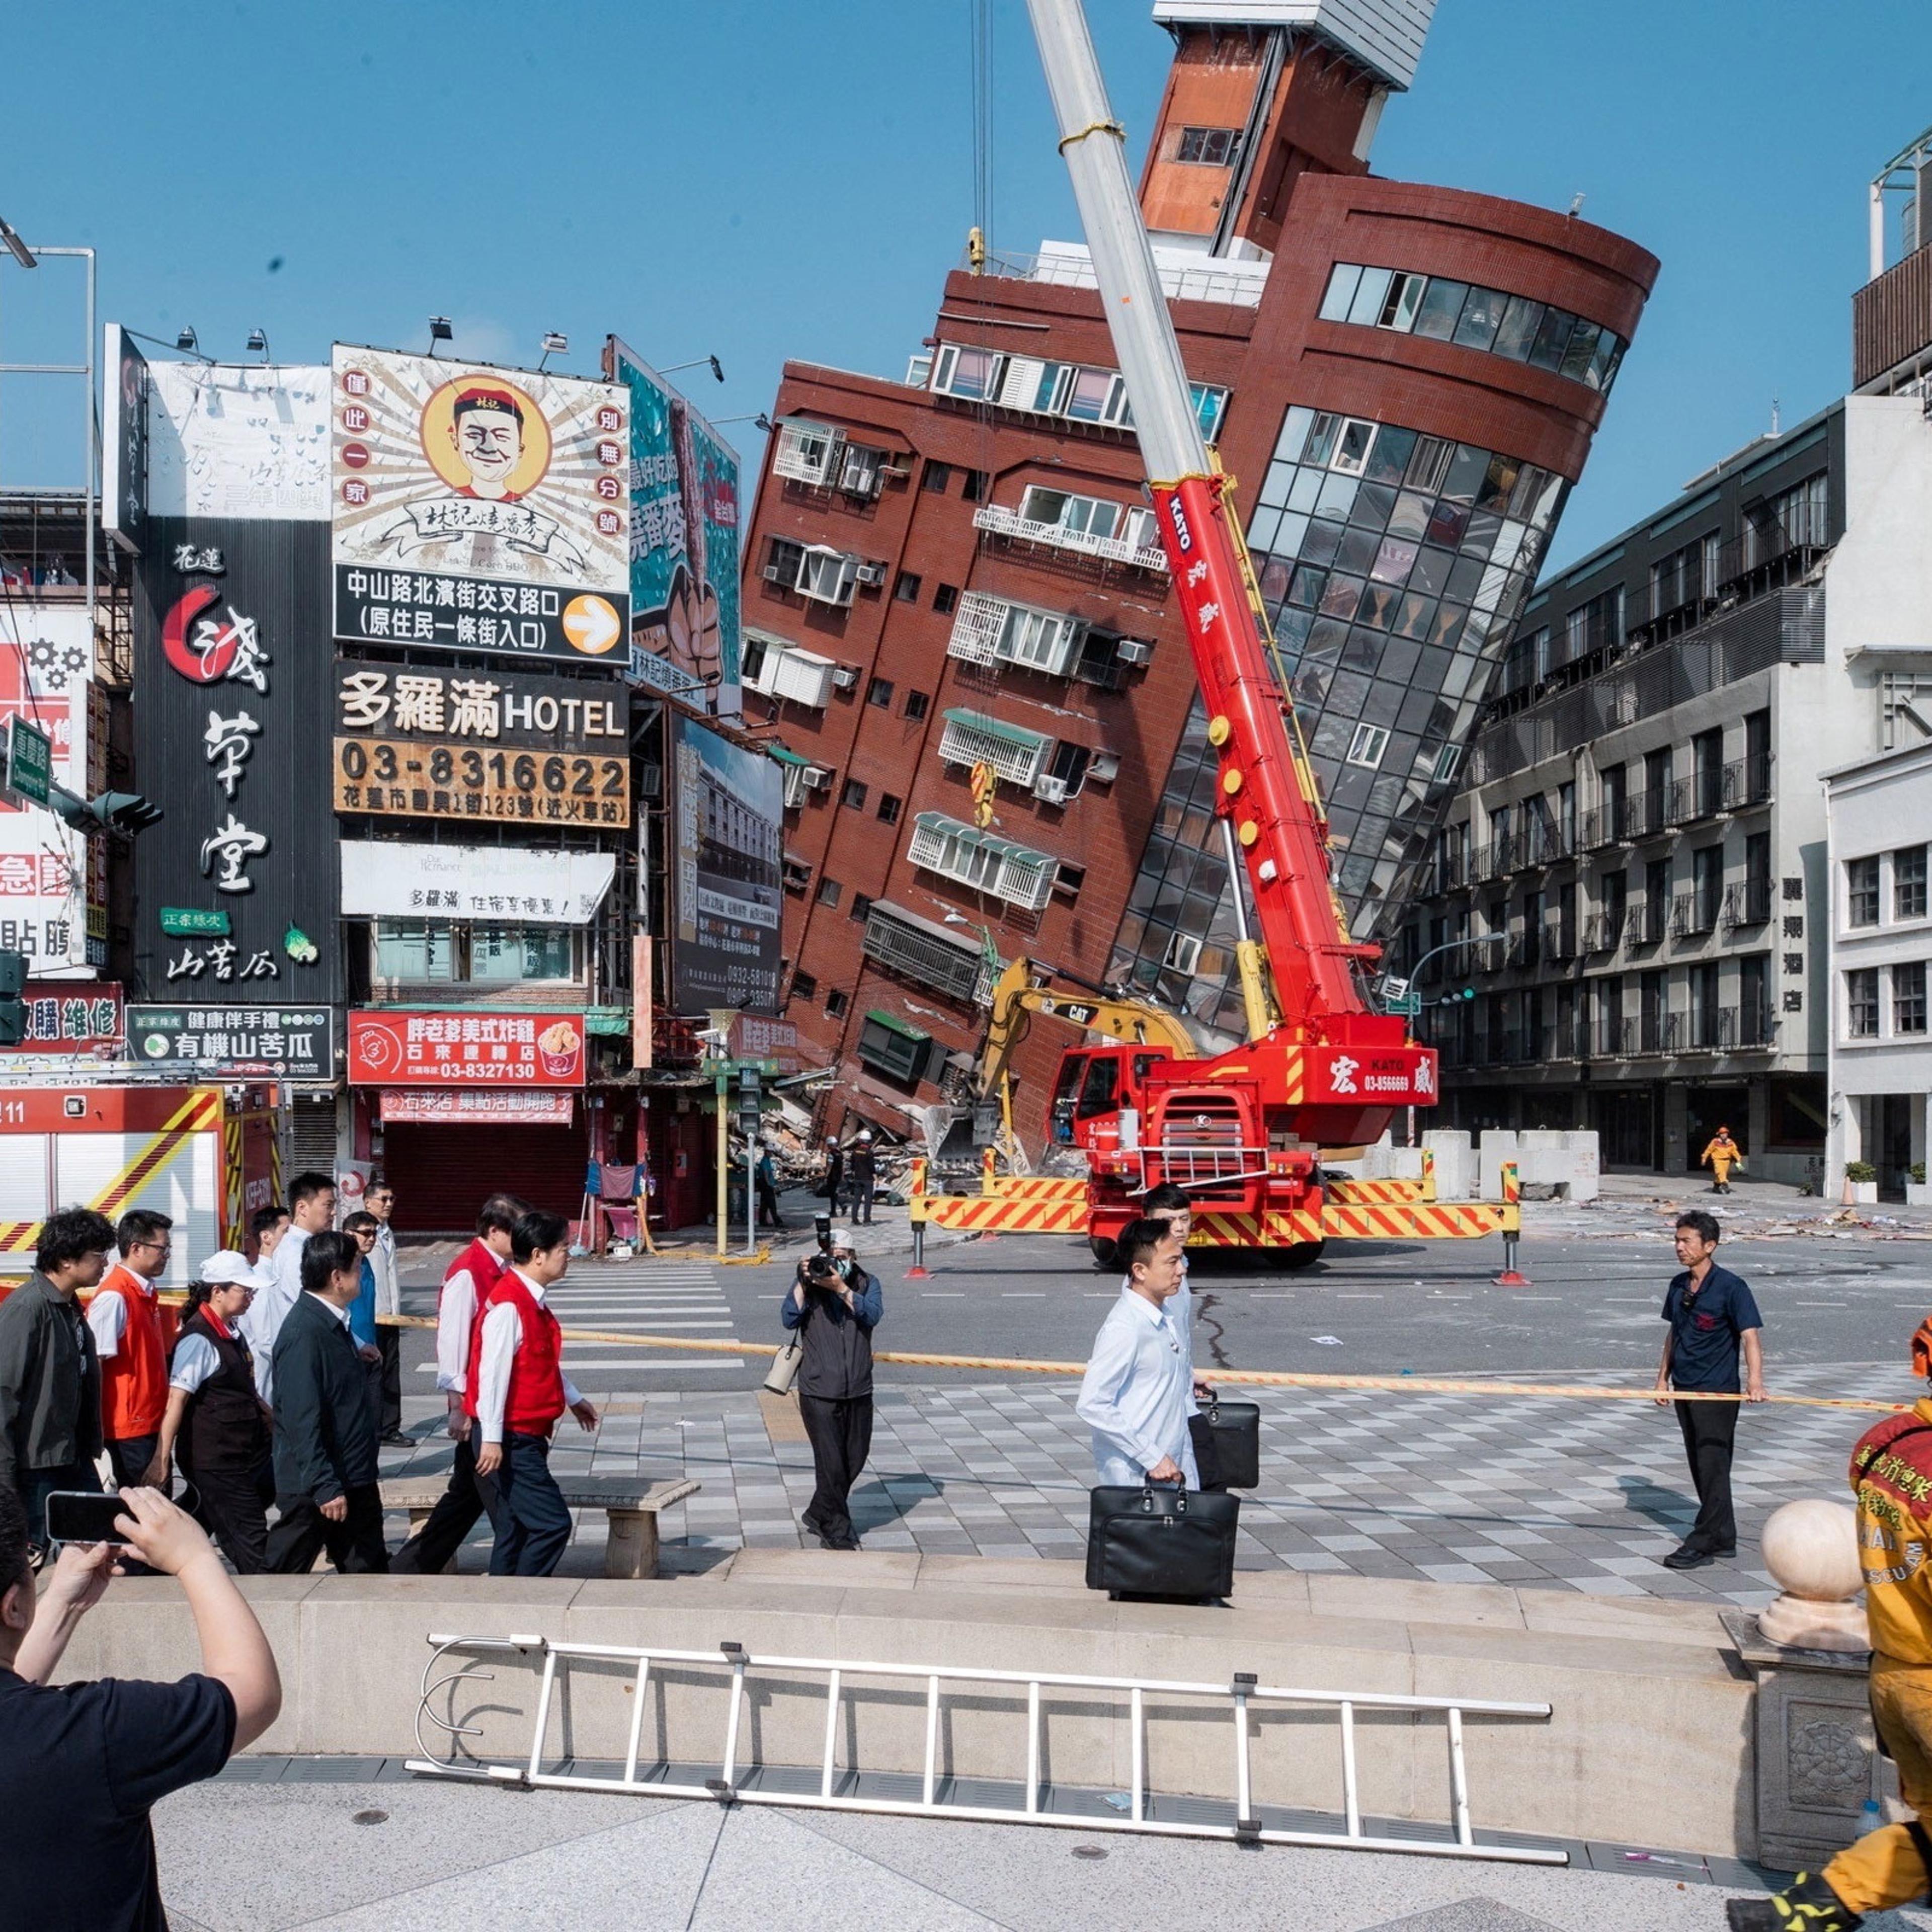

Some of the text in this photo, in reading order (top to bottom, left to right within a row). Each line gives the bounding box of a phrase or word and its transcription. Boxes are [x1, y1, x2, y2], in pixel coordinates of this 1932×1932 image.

[475, 397, 500, 410] 林記
[347, 374, 366, 502] 僅此一家
[599, 411, 619, 533] 別無分號
[1170, 497, 1190, 550] KATO
[174, 544, 224, 571] 花蓮
[347, 570, 559, 617] 中山路北濱街交叉路口
[360, 605, 547, 650] (原住民一條街入口)
[339, 670, 625, 738] 多羅滿 HOTEL
[342, 741, 625, 796] 03-8316622
[411, 889, 460, 909] 多羅滿
[167, 939, 277, 979] 山苦瓜
[23, 998, 116, 1040] 購維修
[188, 1011, 280, 1029] 健康伴手禮
[1069, 1005, 1089, 1023] CAT
[407, 1018, 535, 1043] 胖老爹美式炸雞
[175, 1033, 313, 1058] 有機山苦瓜
[440, 1063, 535, 1078] 03-8327130
[1330, 1056, 1434, 1094] 宏 威
[1372, 1060, 1404, 1071] KATO
[0, 1101, 24, 1123] 11
[1868, 1566, 1907, 1584] SCU
